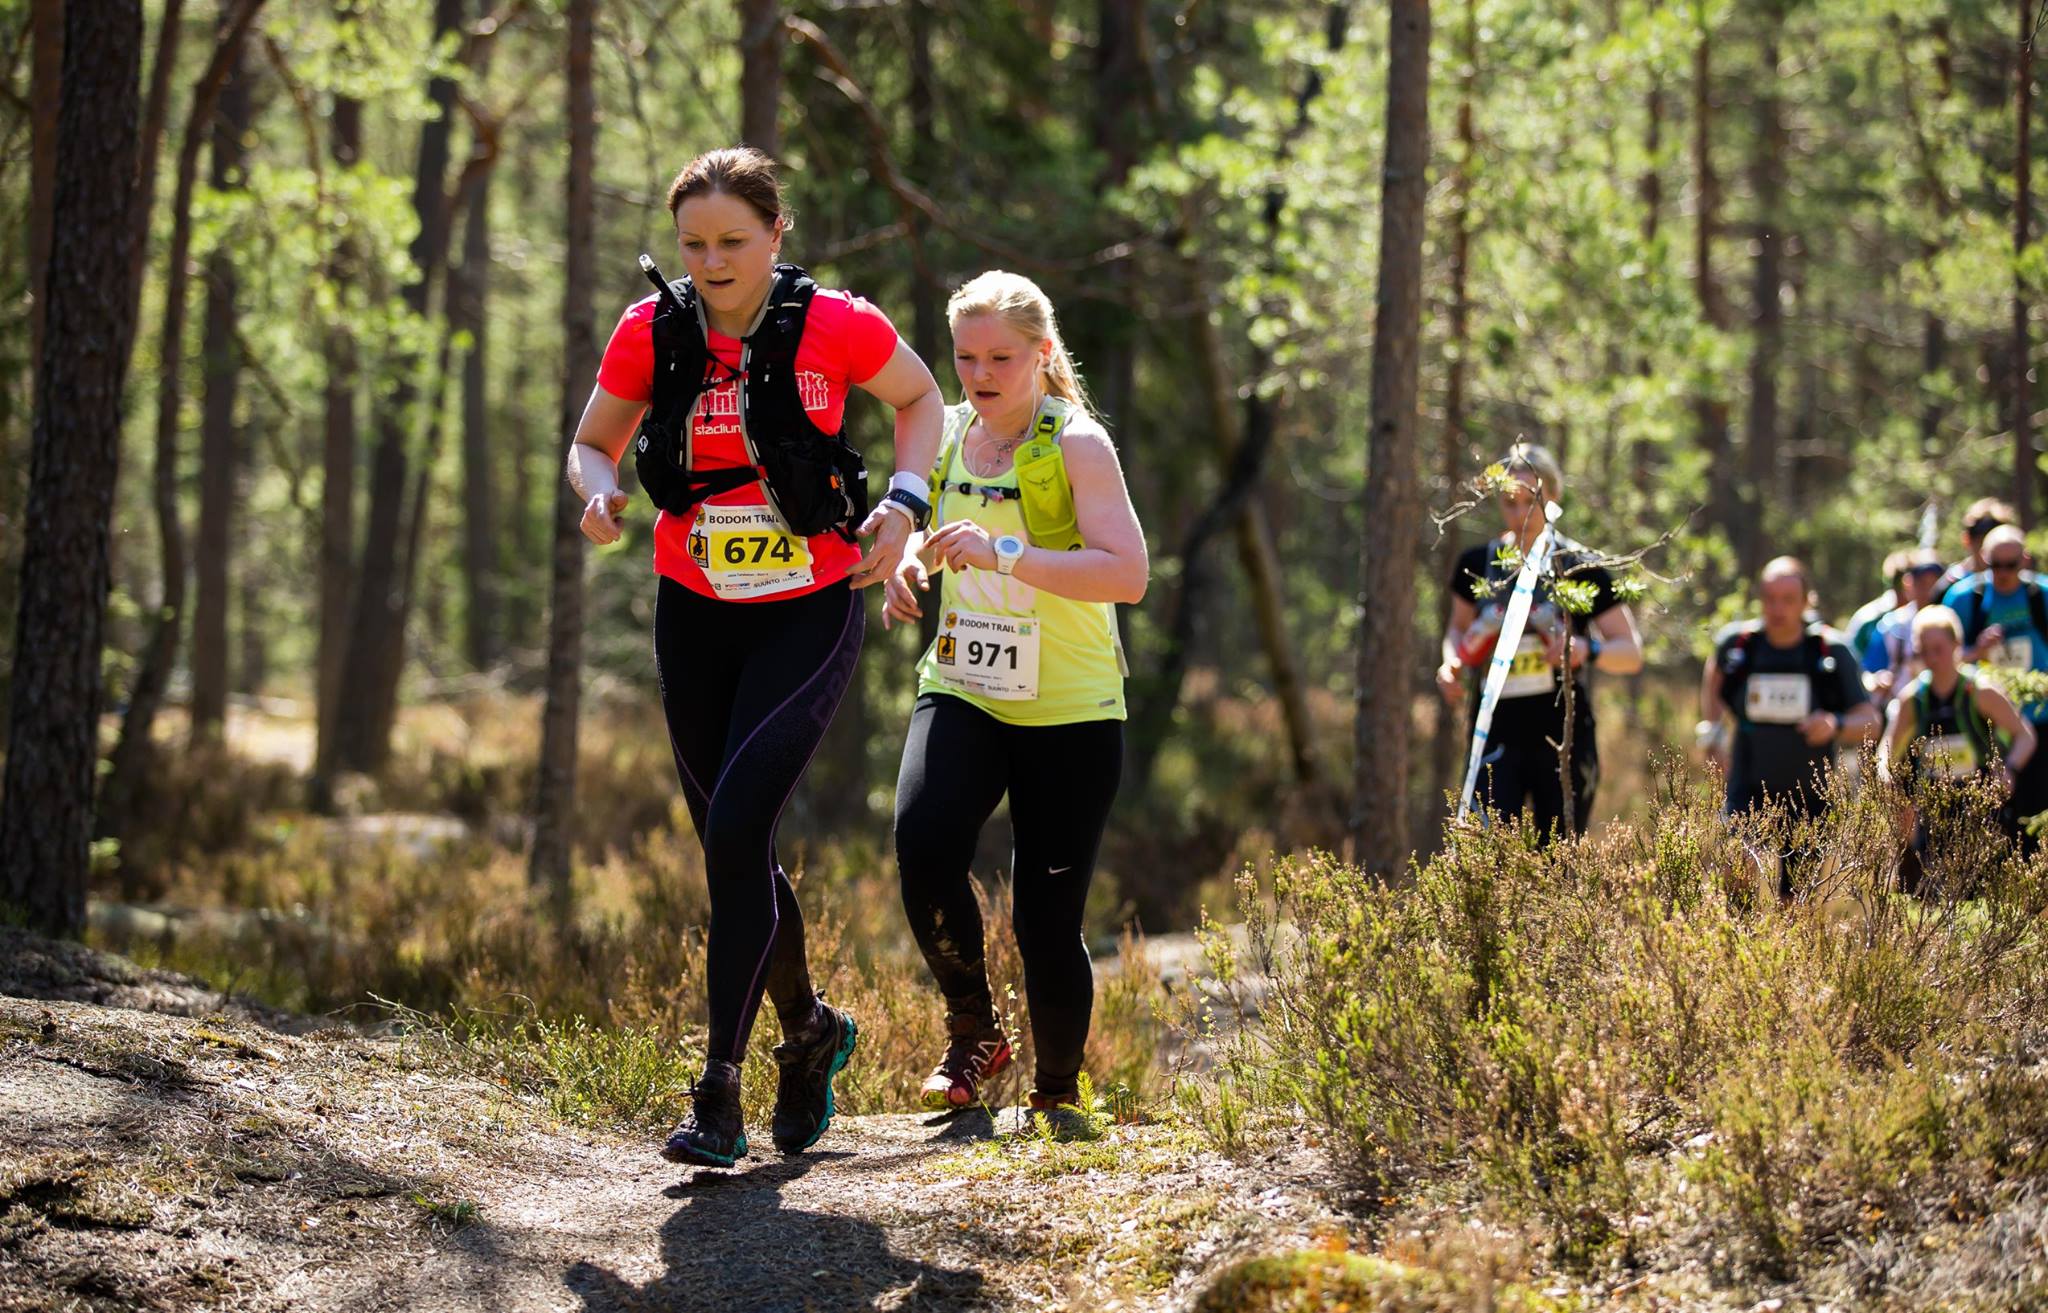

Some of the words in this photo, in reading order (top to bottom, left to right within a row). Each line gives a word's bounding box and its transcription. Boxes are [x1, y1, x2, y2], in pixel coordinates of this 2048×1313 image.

[709, 515, 752, 524] BODOM
[724, 536, 794, 563] 674
[960, 618, 989, 630] BODOM
[993, 623, 1016, 633] TRAIL
[968, 641, 1018, 670] 971
